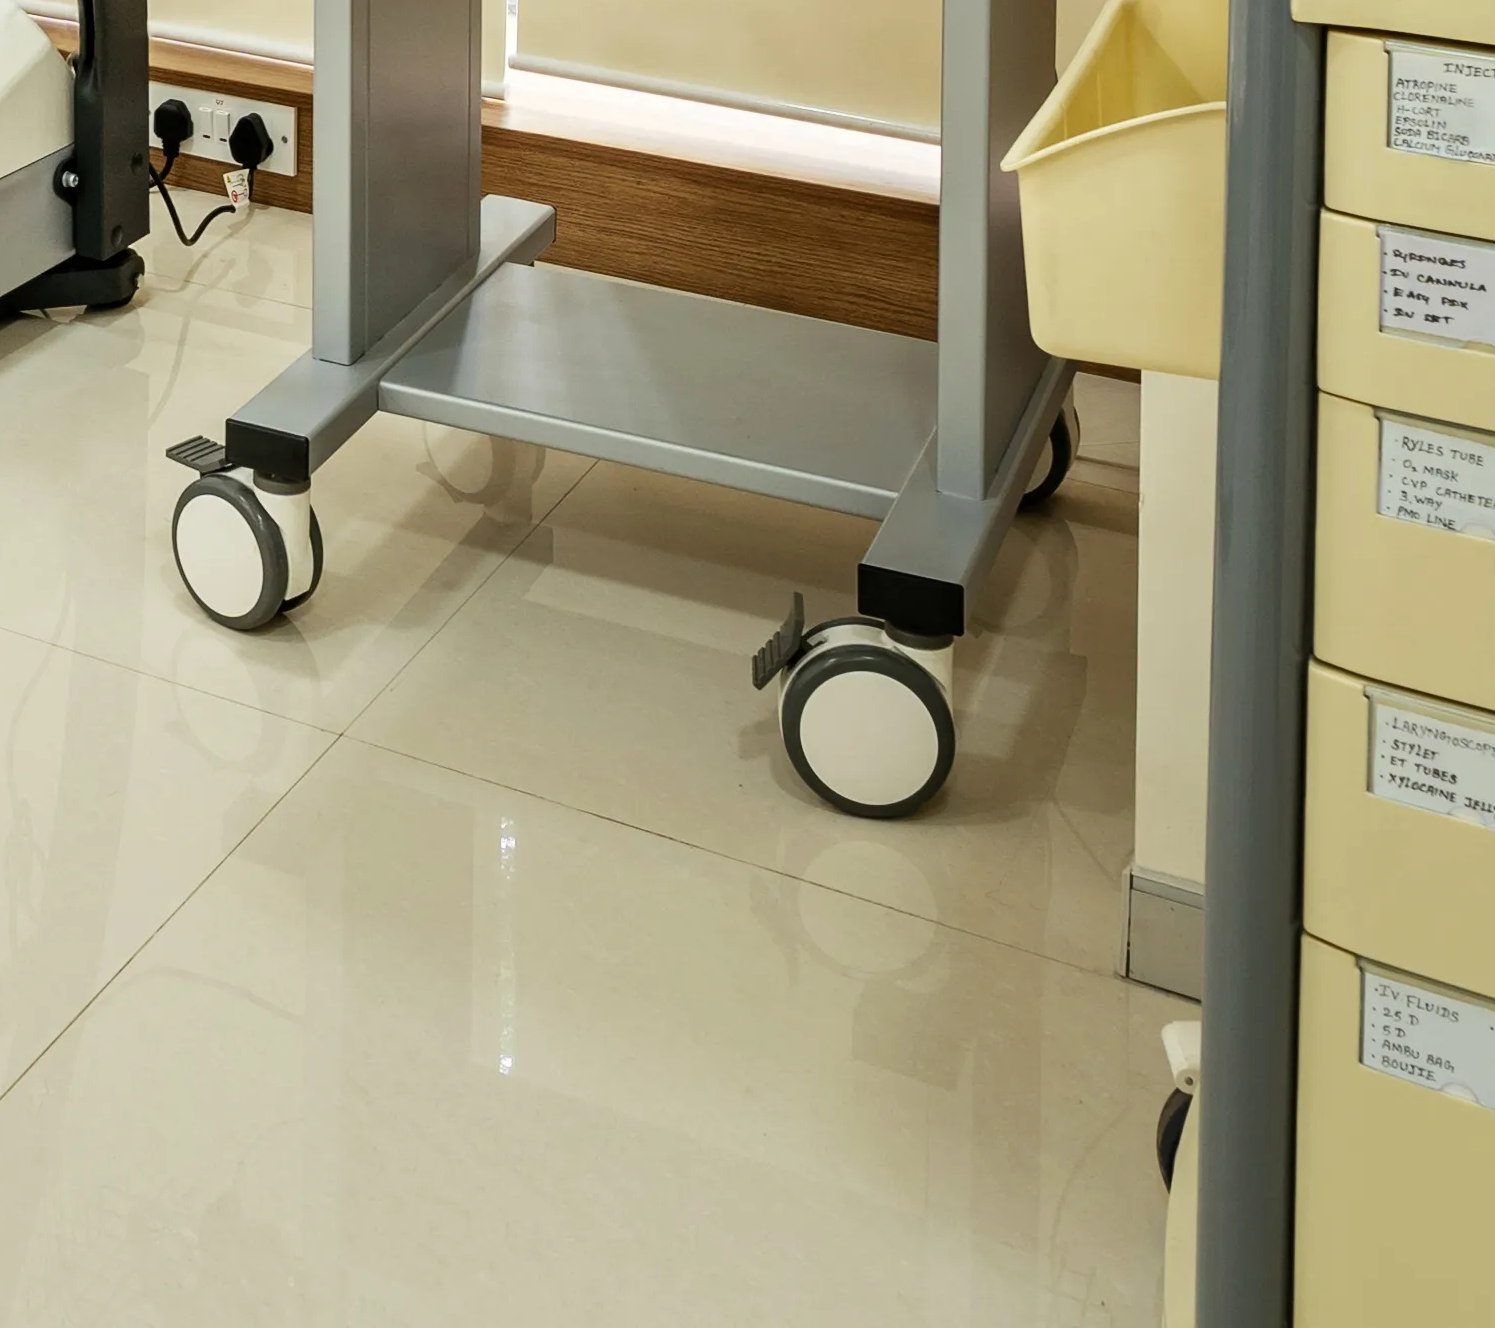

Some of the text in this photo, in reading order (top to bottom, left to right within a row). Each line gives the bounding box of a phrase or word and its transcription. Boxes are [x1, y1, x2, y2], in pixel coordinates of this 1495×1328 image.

[1395, 78, 1457, 94] ATROPINE
[1396, 105, 1442, 117] H-CORT
[1393, 138, 1442, 153] CALCIUM
[1394, 127, 1470, 147] SODA BICARB
[1416, 274, 1487, 292] CANNULA
[1401, 435, 1484, 467] RYLES TUBE
[1401, 476, 1428, 490] CVP
[1423, 465, 1459, 482] MASK
[1426, 513, 1458, 532] LINE
[1391, 738, 1440, 761] STYLET
[1390, 755, 1458, 785] ET TUBES
[1388, 772, 1457, 803] XYLOCAINE
[1382, 1007, 1420, 1027] 25 D
[1406, 995, 1460, 1023] FLUIDS
[1382, 1025, 1407, 1039] 5 D
[1381, 1039, 1455, 1074] AMBU BAG
[1381, 1055, 1437, 1082] BOUJIE
